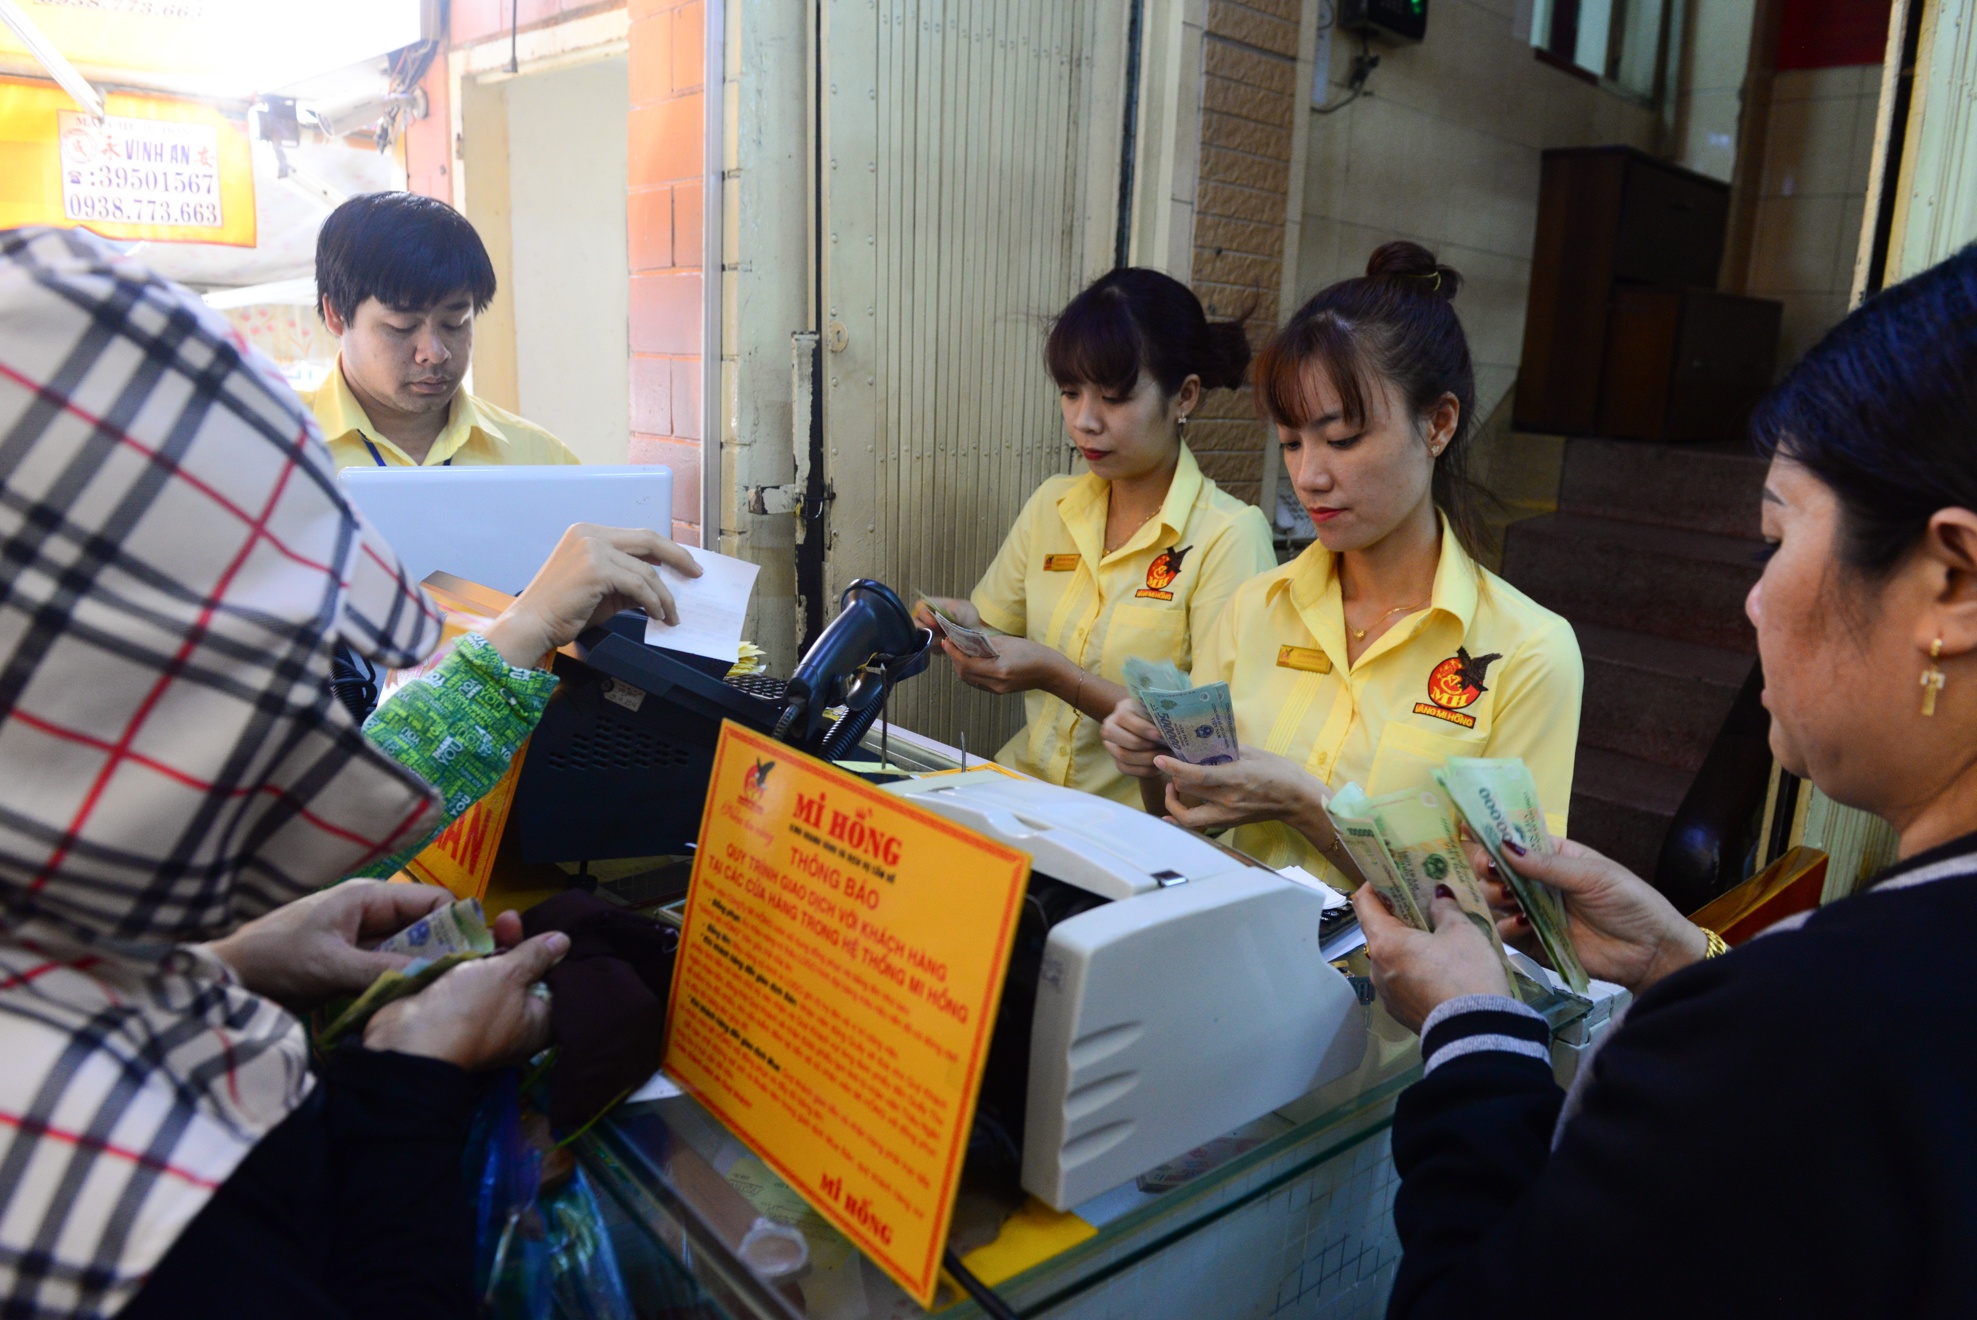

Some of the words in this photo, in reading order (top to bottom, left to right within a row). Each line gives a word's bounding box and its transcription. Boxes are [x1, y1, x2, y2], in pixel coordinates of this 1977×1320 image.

[170, 143, 190, 165] AN
[70, 194, 217, 224] 0938.773.663
[1430, 686, 1470, 707] MH
[436, 737, 465, 768] YOU
[449, 794, 472, 817] YOU
[790, 845, 841, 890] THÔNG
[843, 874, 880, 911] BÁO
[722, 861, 745, 889] CÁC
[766, 888, 799, 922] HÀNG
[799, 908, 840, 948] TRONG
[860, 944, 907, 988] THỐNG
[779, 871, 807, 902] GIAO
[859, 917, 906, 960] KHÁCH
[906, 944, 948, 985] HÀNG
